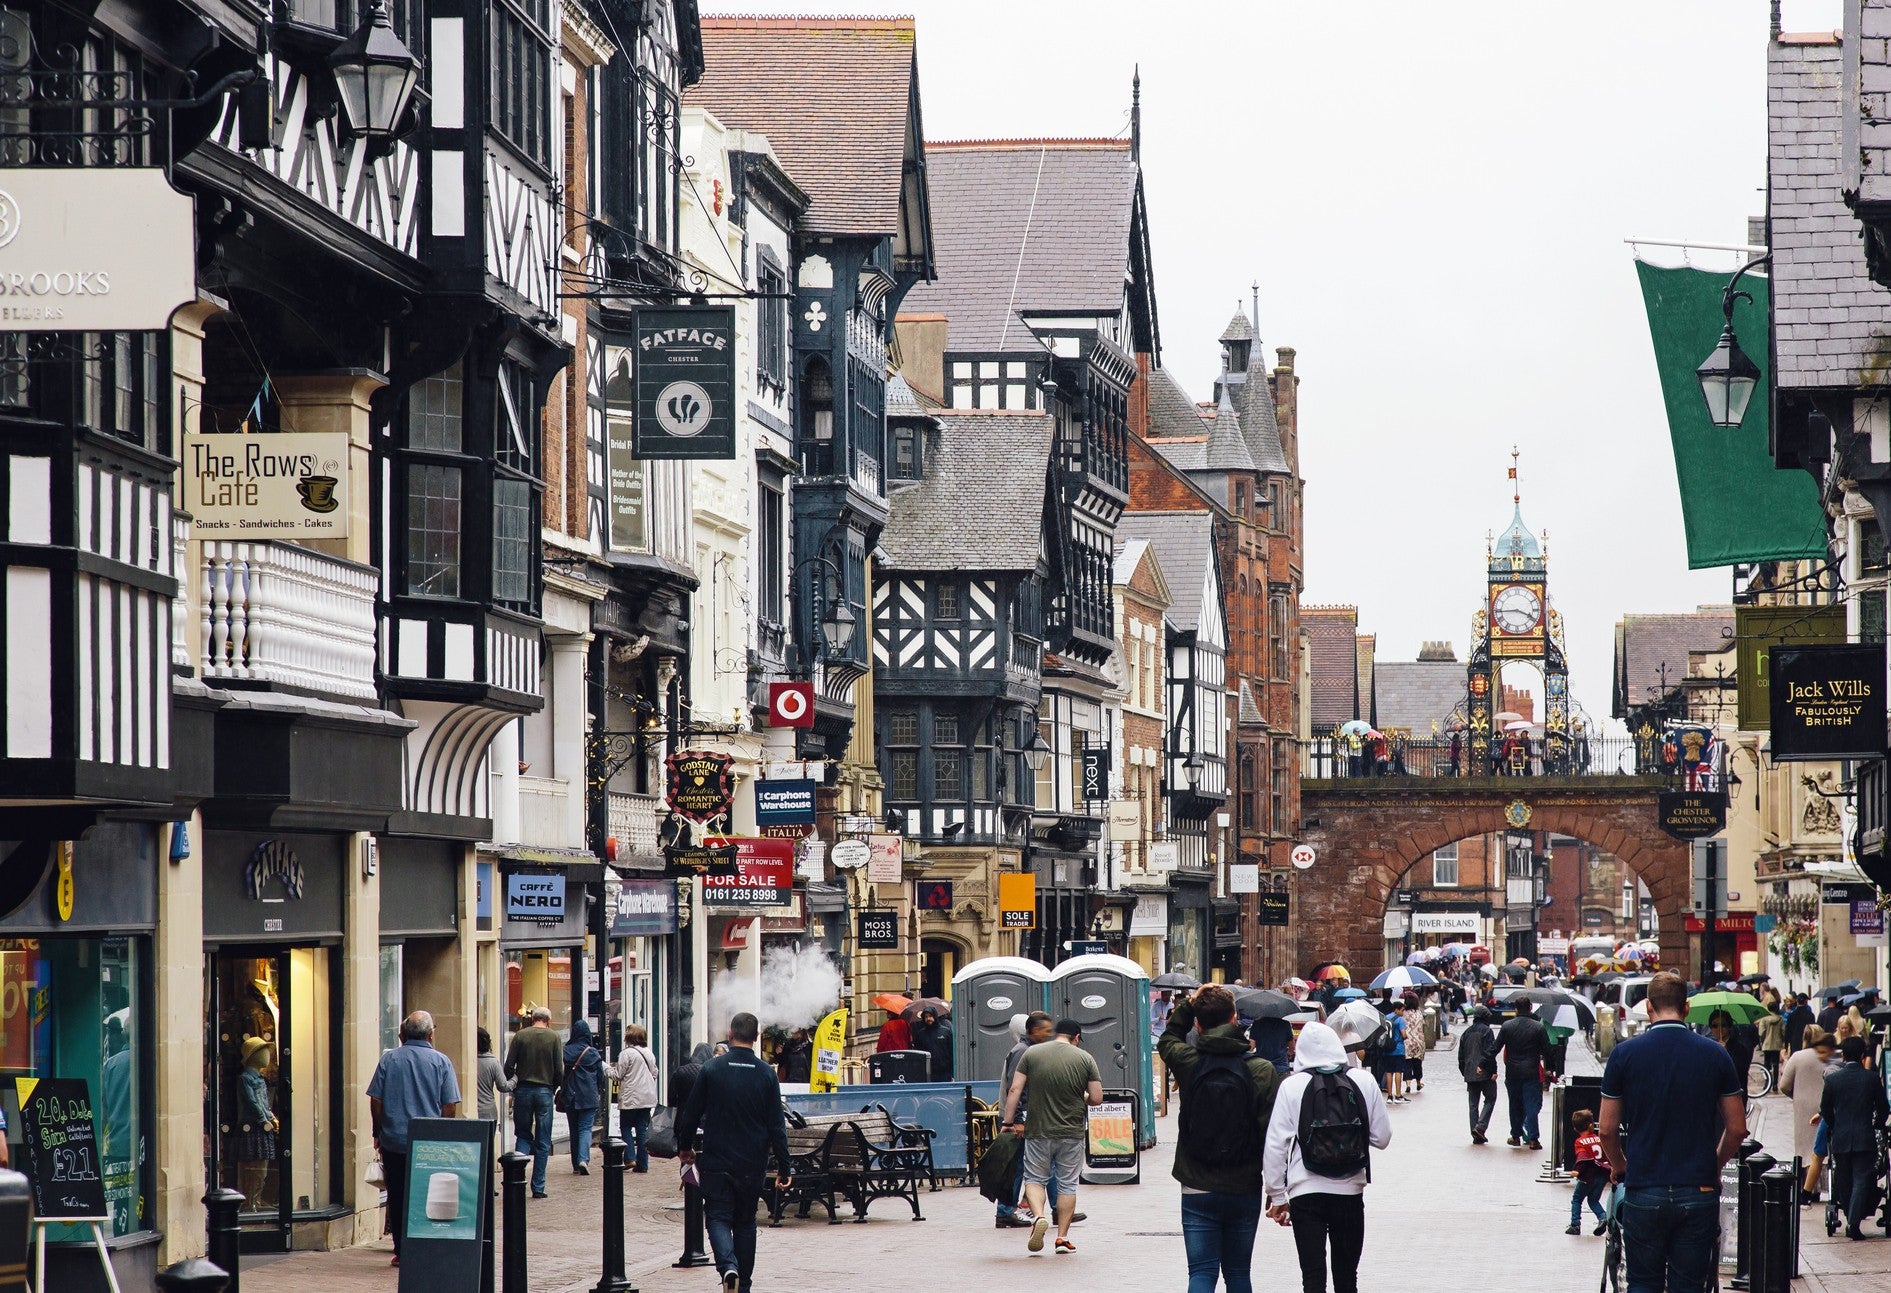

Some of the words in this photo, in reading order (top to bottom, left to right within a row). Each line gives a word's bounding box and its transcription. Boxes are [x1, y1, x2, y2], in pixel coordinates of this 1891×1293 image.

[640, 328, 727, 351] FATFACE
[610, 439, 627, 449] Bridal
[191, 444, 219, 477] The
[246, 444, 312, 477] Rows
[201, 470, 258, 506] Café
[196, 519, 230, 529] Snacks
[240, 519, 295, 528] Sandwiches
[304, 518, 333, 528] Cakes
[1510, 555, 1525, 570] VR
[1491, 626, 1501, 636] 18
[1533, 626, 1544, 636] 97
[1786, 680, 1823, 702] Jack
[1828, 680, 1871, 696] Wills
[1795, 706, 1861, 716] FABULOUSLY
[1806, 716, 1852, 726] BRITISH
[680, 761, 719, 773] GODSTALL
[688, 768, 710, 776] LANE
[1086, 756, 1098, 796] next
[677, 795, 722, 803] ROMANTIC
[764, 791, 811, 801] Carphone
[686, 801, 713, 809] HEART
[760, 801, 812, 810] Warehouse
[1684, 799, 1702, 807] THE
[1673, 808, 1711, 816] CHESTER
[1666, 816, 1717, 824] GROSVENOR
[768, 829, 804, 837] ITALIA
[706, 875, 736, 886] FOR
[739, 875, 777, 886] SALE
[519, 882, 554, 892] CAFFÈ
[705, 889, 729, 900] 0161
[732, 889, 751, 900] 235
[752, 889, 777, 901] 8998
[1830, 887, 1848, 898] Centre
[511, 896, 562, 907] NERO
[618, 889, 642, 919] Carphone
[641, 889, 668, 914] Warehouse
[1006, 912, 1029, 920] SOLE
[864, 921, 891, 930] MOSS
[1418, 919, 1441, 927] RIVER
[1444, 919, 1474, 927] ISLAND
[864, 930, 894, 938] BROS.
[824, 1050, 833, 1058] THE
[818, 1057, 839, 1066] LEATHER
[1092, 1118, 1132, 1139] SALE
